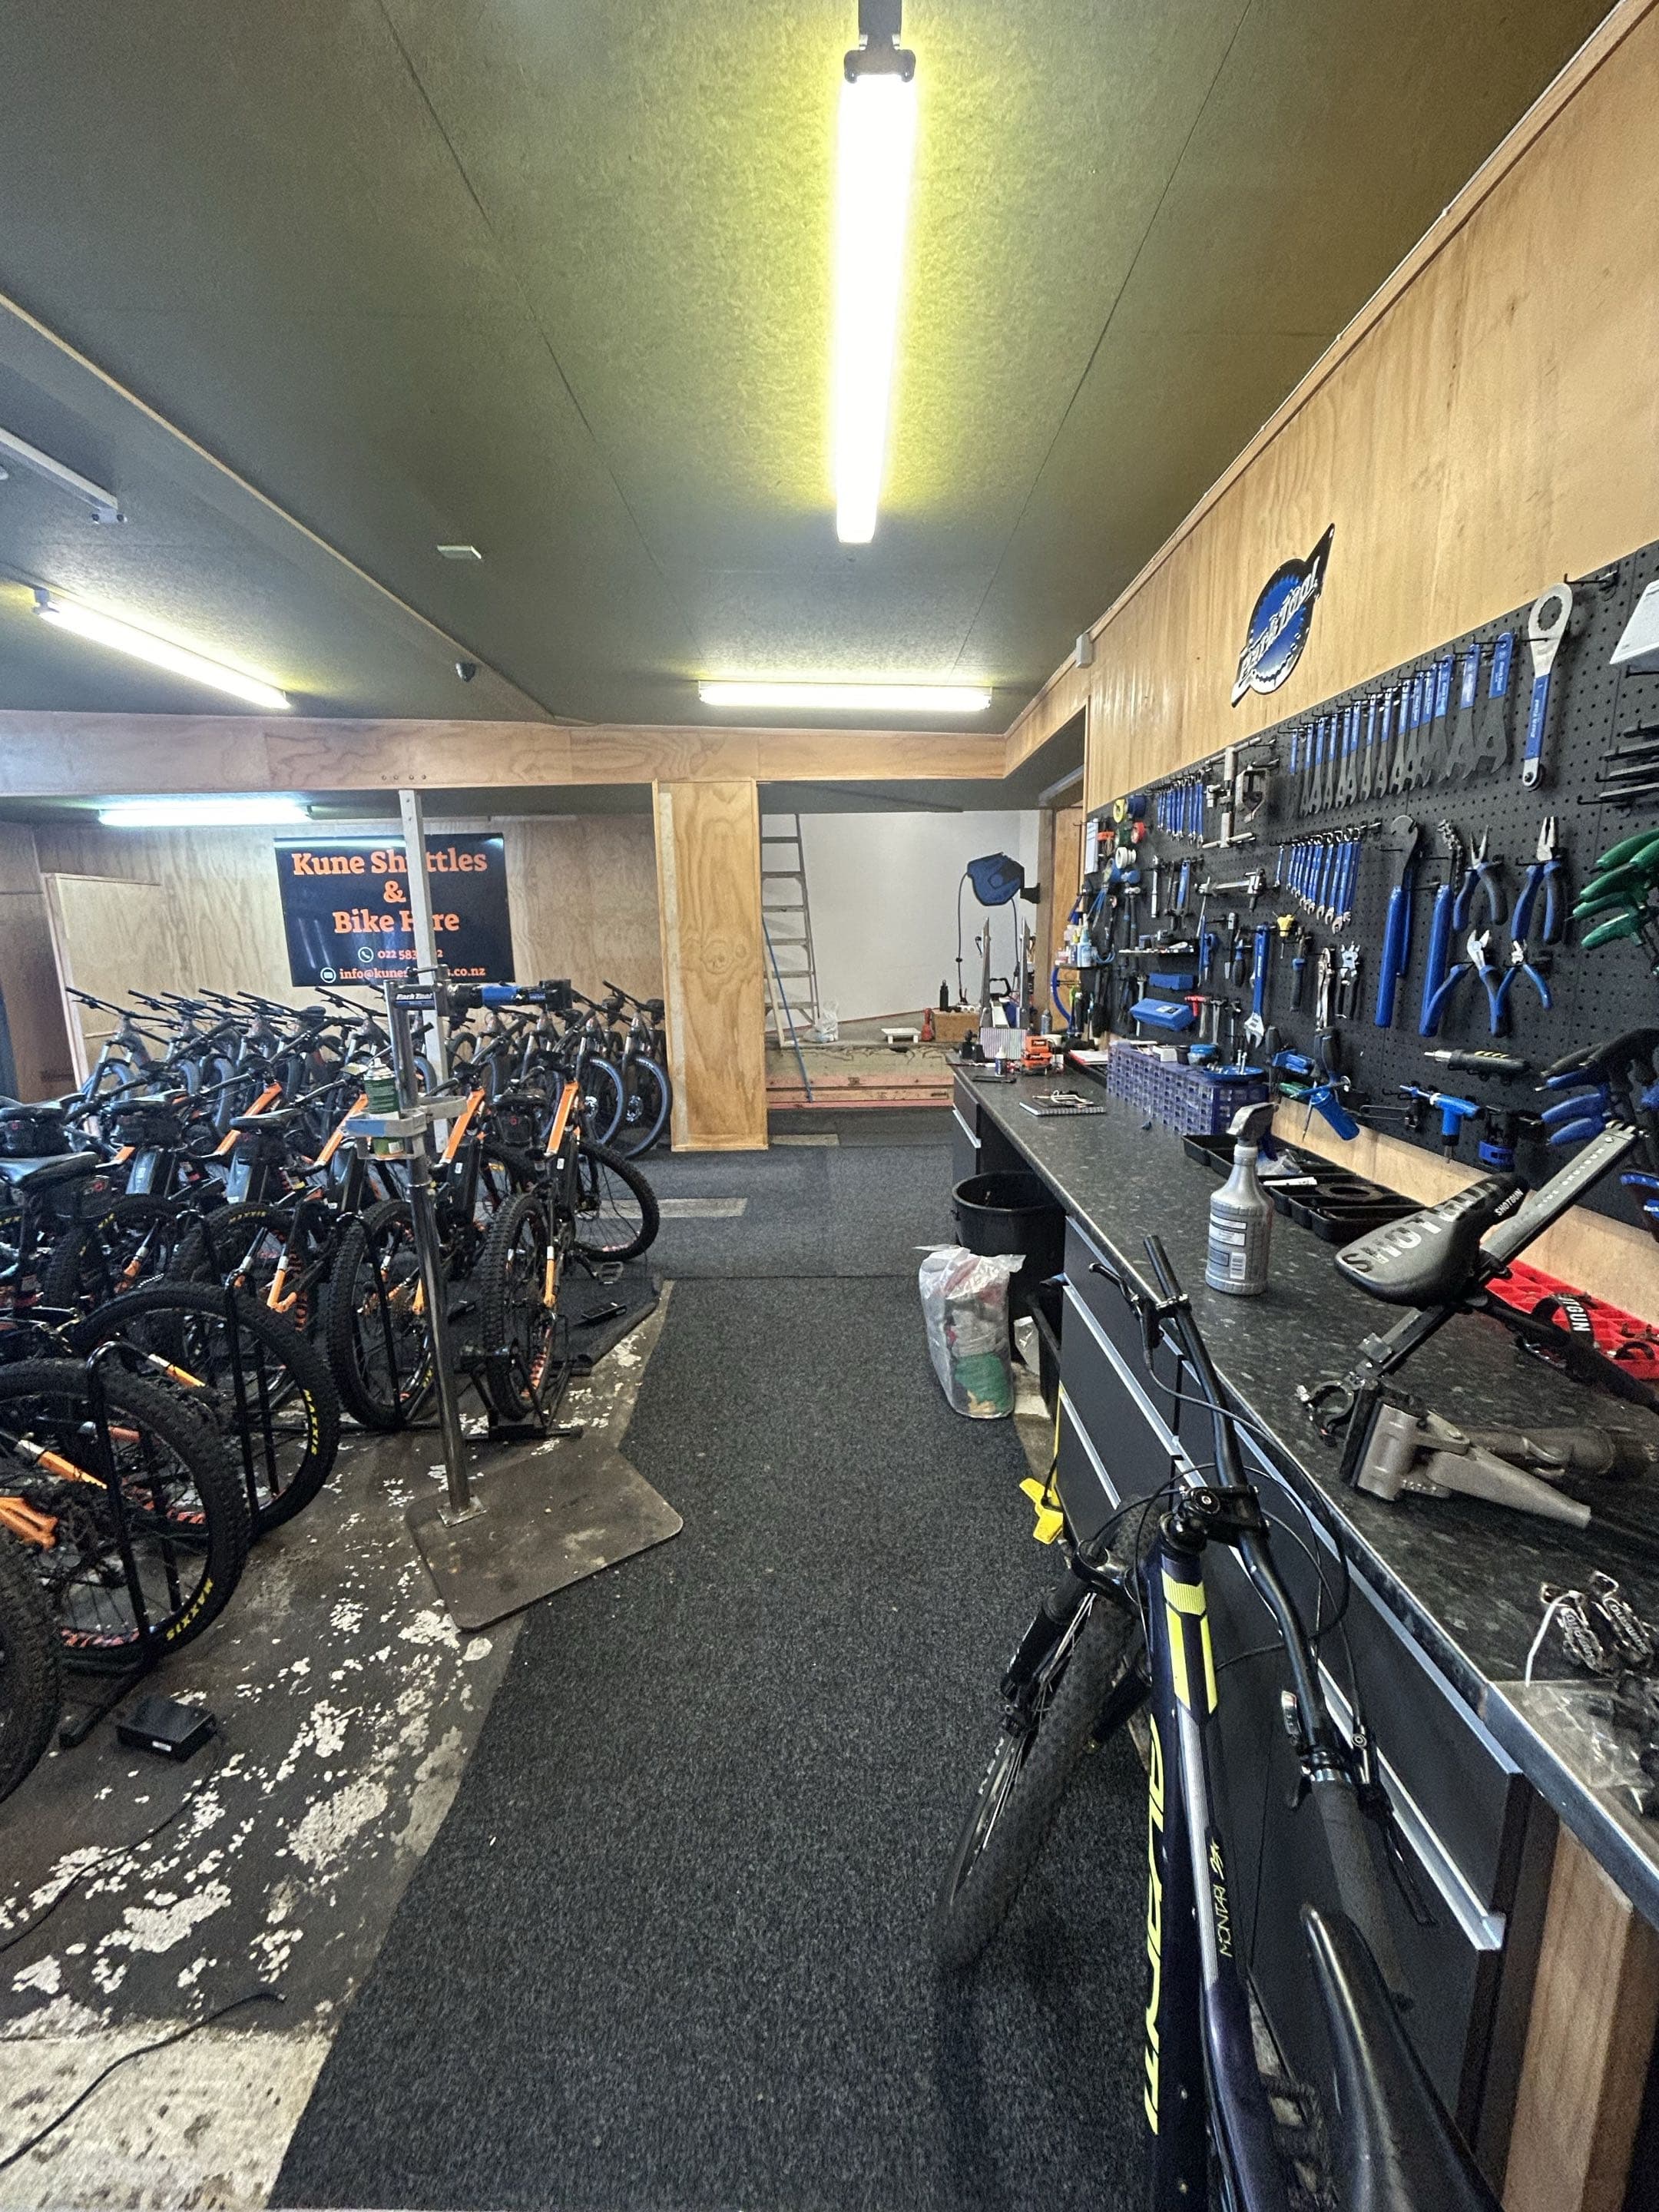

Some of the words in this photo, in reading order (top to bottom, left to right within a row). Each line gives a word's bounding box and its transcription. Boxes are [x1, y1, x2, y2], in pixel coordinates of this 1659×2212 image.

[291, 853, 364, 876] Kune
[371, 847, 488, 874] Shttles
[383, 880, 406, 903] &
[333, 908, 394, 934] Bike
[399, 910, 459, 932] Hre
[377, 950, 396, 959] 022
[1494, 1188, 1524, 1217] SHOTGUN
[1343, 1181, 1498, 1273] SHOTGUN
[302, 1389, 320, 1455] MAXXIS
[165, 1577, 214, 1641] MAXXIS
[1144, 1713, 1164, 2135] AVANTI
[1213, 1884, 1233, 1958] MONTARI
